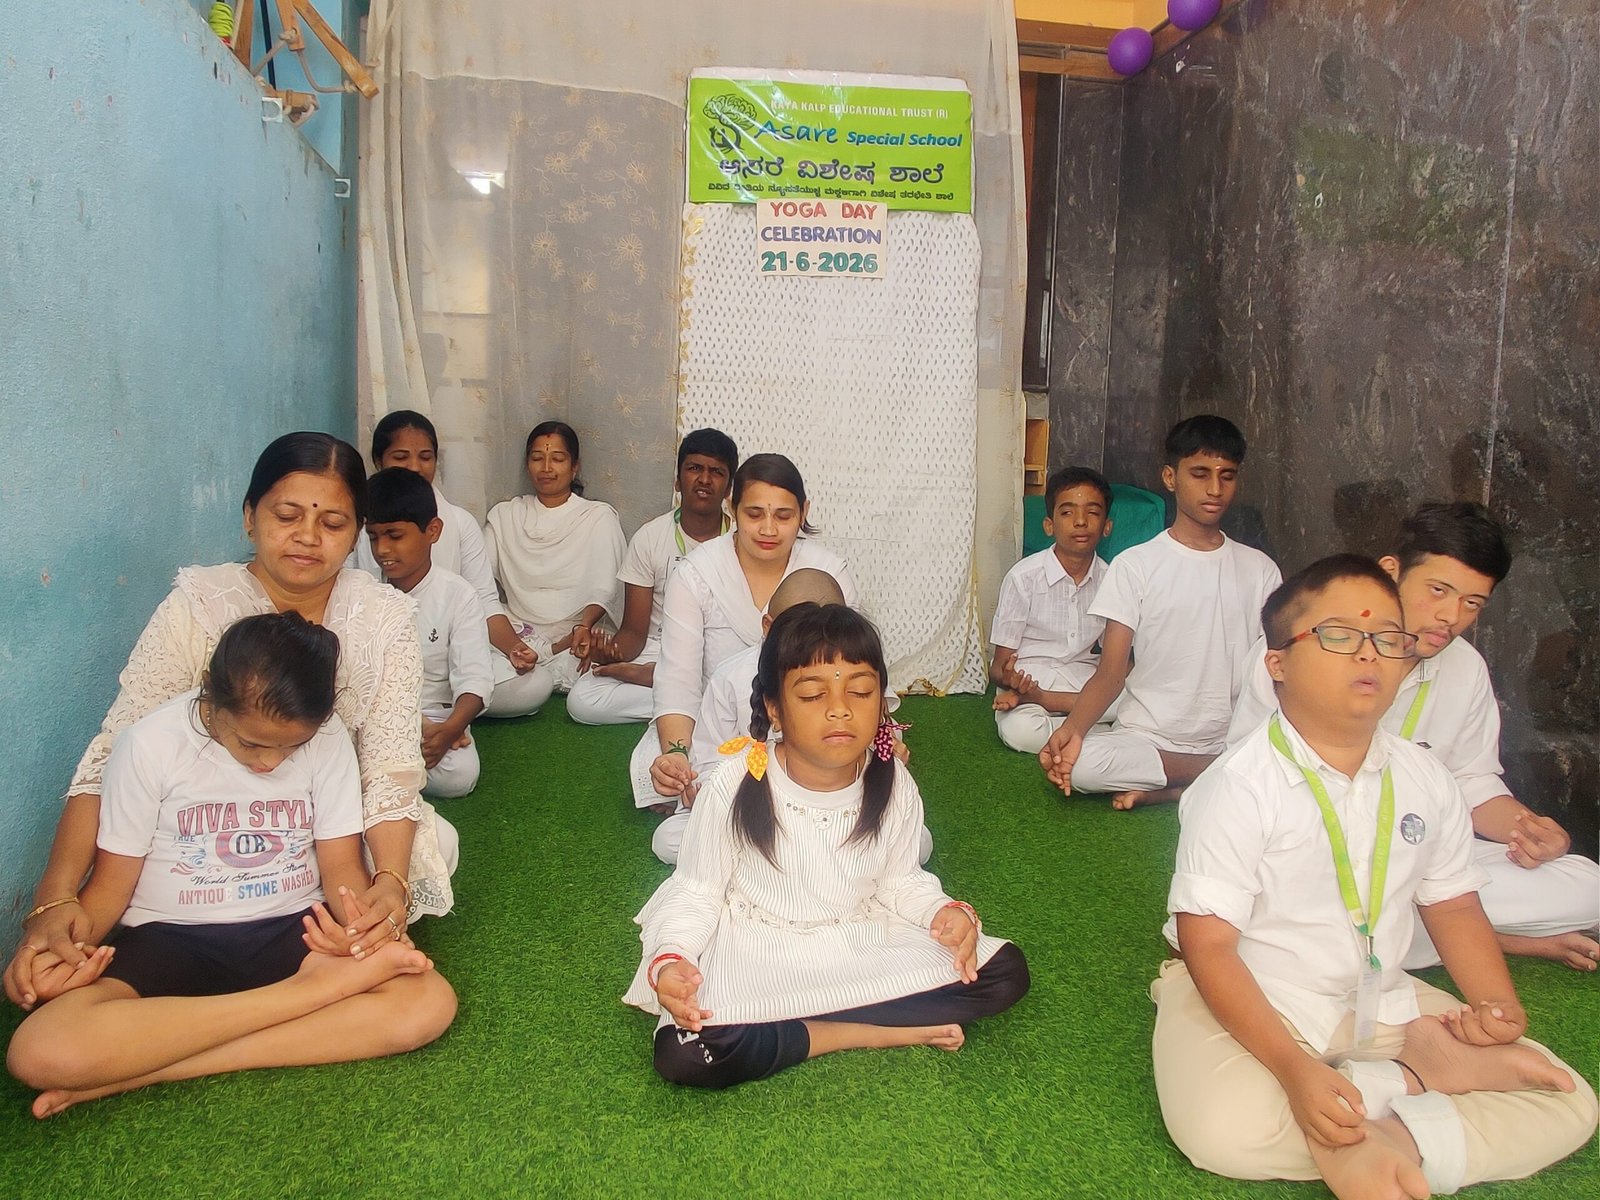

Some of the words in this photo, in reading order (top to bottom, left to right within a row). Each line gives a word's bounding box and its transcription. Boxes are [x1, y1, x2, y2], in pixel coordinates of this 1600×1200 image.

[801, 102, 826, 112] KALP
[829, 104, 898, 116] EDUCATIONAL
[901, 107, 933, 118] TRUST
[936, 109, 948, 119] (R)
[754, 120, 838, 143] Asare
[847, 131, 905, 146] Special
[908, 133, 963, 147] School
[797, 159, 876, 185] ವಿಶೇಷ
[889, 163, 945, 184] ಶಾಲೆ
[770, 202, 827, 219] YOGA
[841, 202, 877, 220] DAY
[760, 226, 882, 244] CELEBRATION
[761, 251, 879, 274] 21-6-2026
[177, 802, 240, 837] VIVA
[248, 799, 312, 830] STYL
[238, 880, 278, 899] STONE
